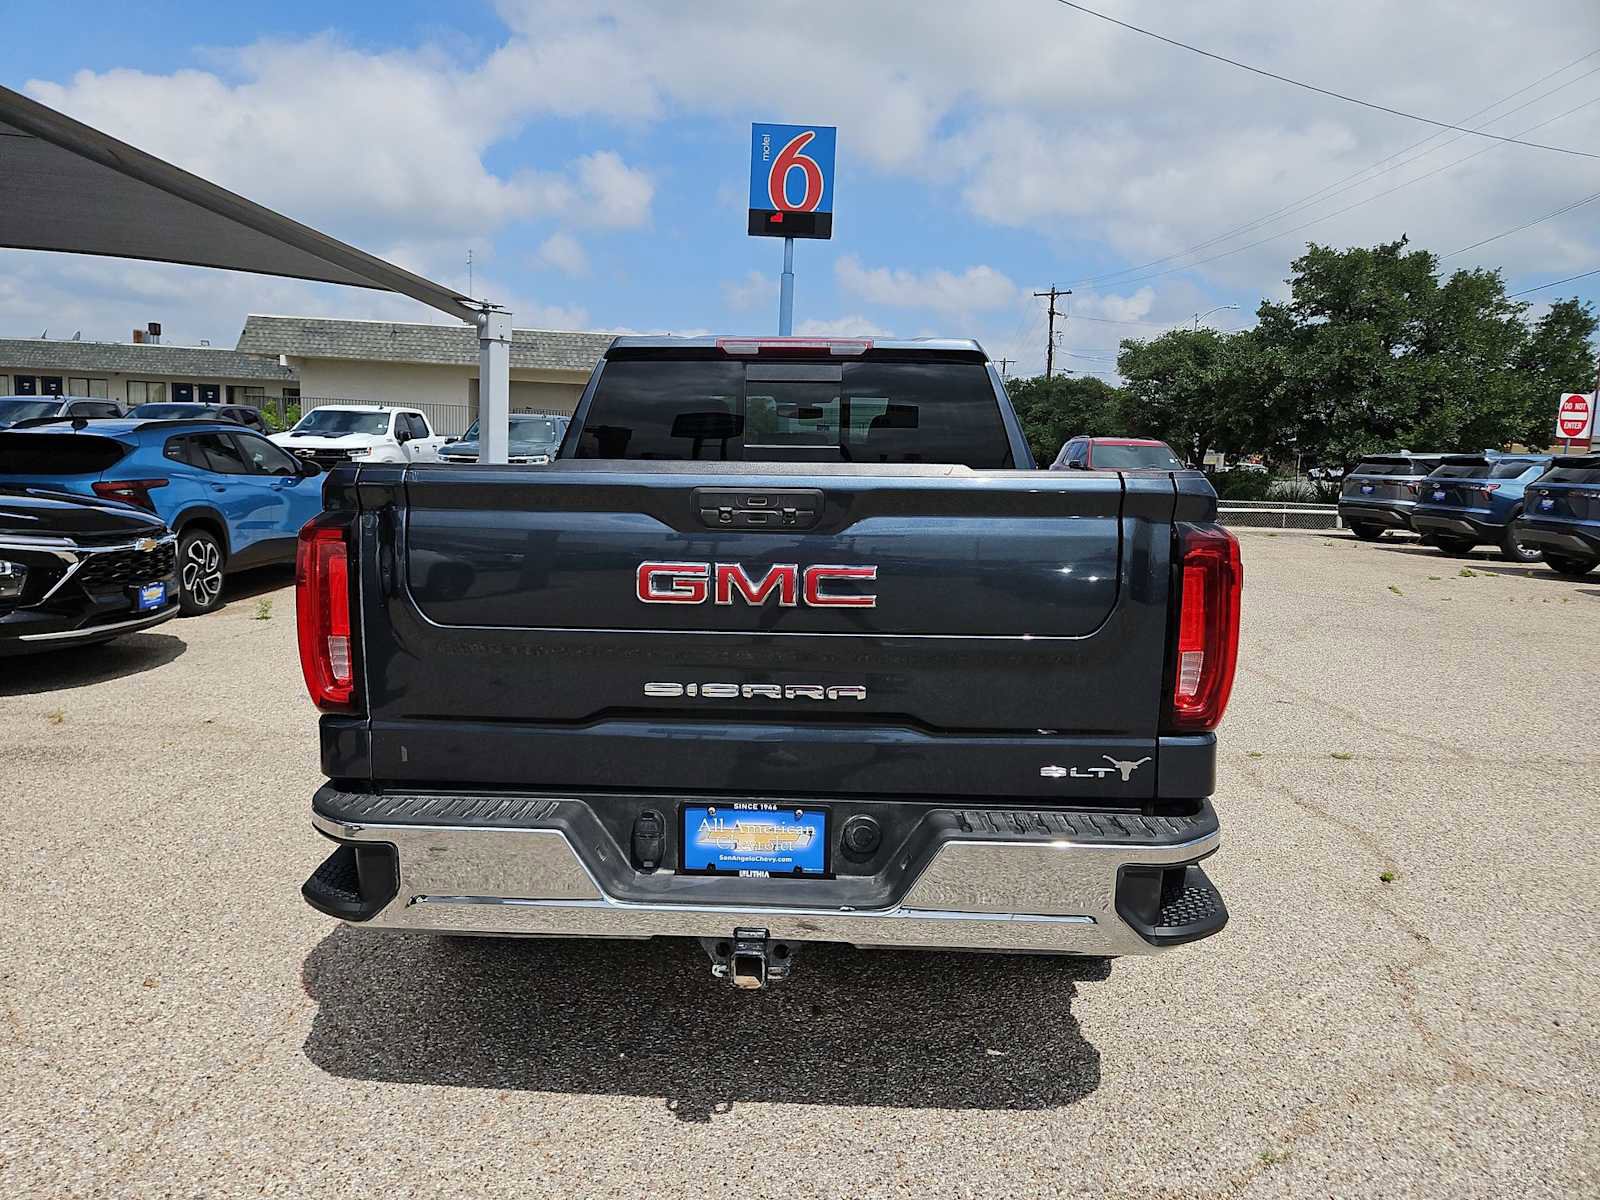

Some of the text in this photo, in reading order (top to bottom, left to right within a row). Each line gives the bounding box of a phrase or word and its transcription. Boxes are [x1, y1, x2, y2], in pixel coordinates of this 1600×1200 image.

[762, 134, 771, 161] motel
[768, 130, 825, 212] 6
[1564, 402, 1587, 410] DO NOT
[1563, 421, 1583, 430] ENTER
[636, 561, 878, 607] GMC
[644, 682, 867, 701] SIERRA
[1040, 766, 1116, 778] SLT
[760, 803, 778, 811] 1946
[698, 817, 817, 835] All American
[719, 854, 793, 863] SanAngeloChevy.com
